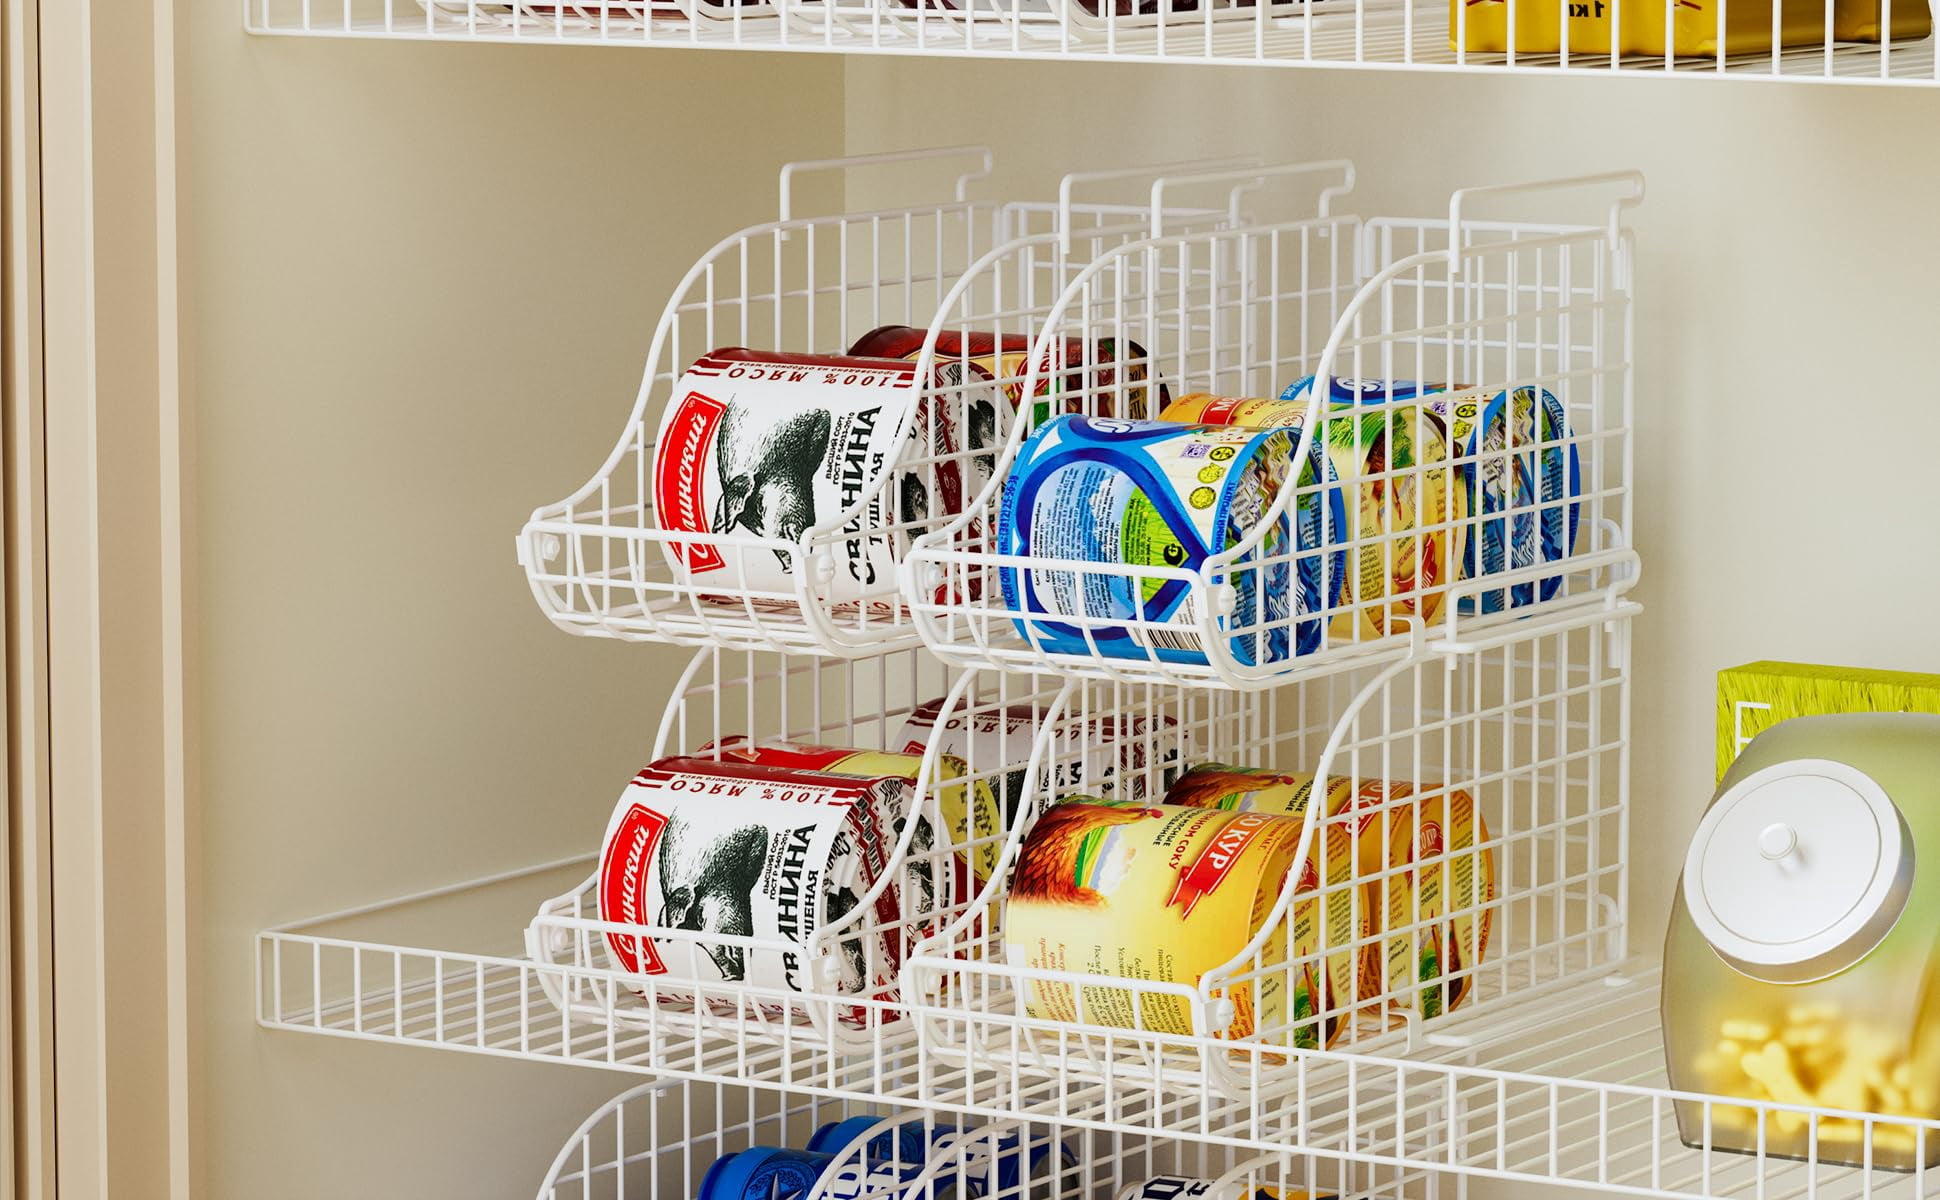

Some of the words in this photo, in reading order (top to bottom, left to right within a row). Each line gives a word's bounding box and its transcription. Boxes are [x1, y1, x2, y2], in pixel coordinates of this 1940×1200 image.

[727, 367, 807, 382] МЯСО
[822, 374, 891, 387] 100%
[826, 438, 838, 479] ВЫСШИЙ
[833, 416, 845, 437] СОРТ
[833, 462, 841, 484] ГОСТ
[1219, 482, 1236, 518] ПРОДУКТ
[669, 780, 746, 796] МЯСО
[759, 789, 825, 804] 100%
[1163, 820, 1189, 846] МЯСНЫЕ
[1169, 841, 1188, 869] СОКУ
[1208, 830, 1249, 867] КУР
[763, 854, 776, 894] ВЫСШИЙ
[770, 832, 782, 853] СОРТ
[619, 825, 651, 962] Еинский
[770, 878, 778, 899] ГОСТ
